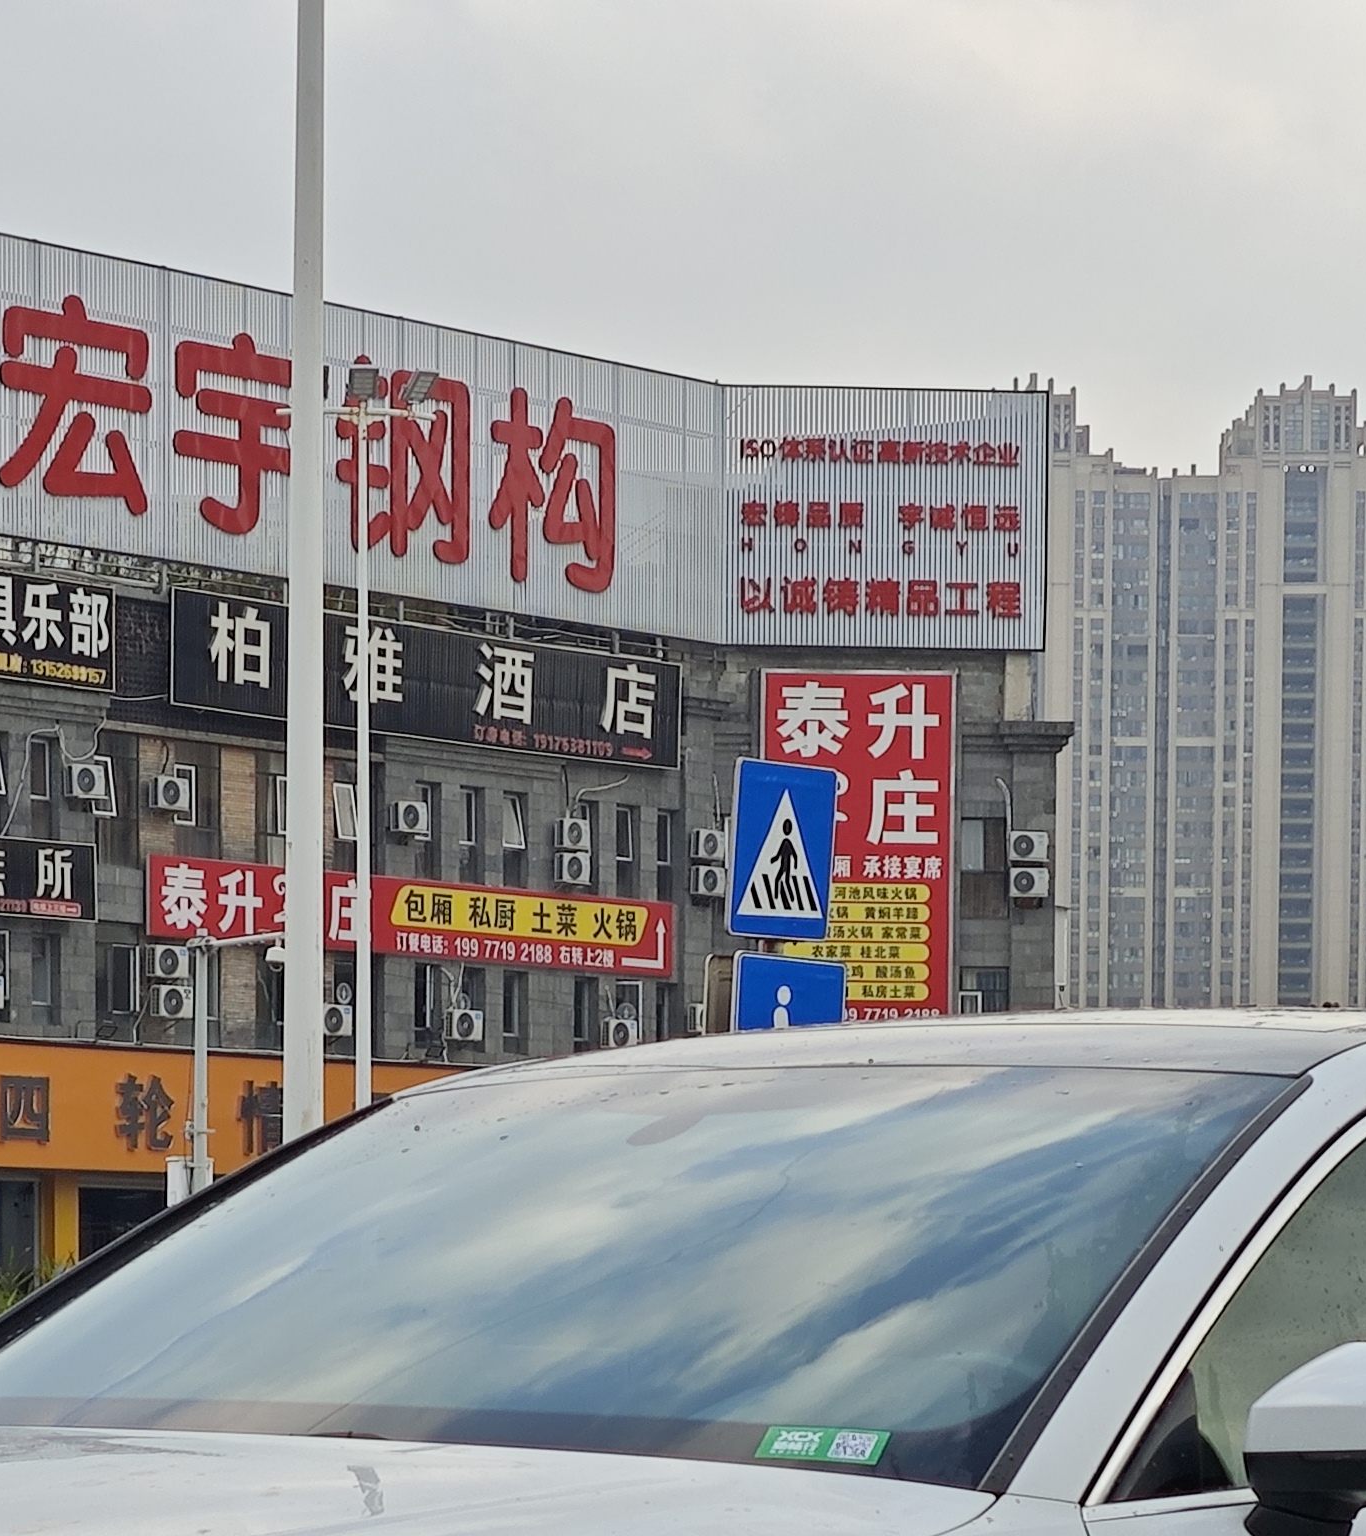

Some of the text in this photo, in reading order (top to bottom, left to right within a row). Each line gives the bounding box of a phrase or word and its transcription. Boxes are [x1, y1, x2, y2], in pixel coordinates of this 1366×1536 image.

[209, 600, 658, 740] 柏雅酒店
[776, 680, 941, 761] 泰升
[863, 855, 943, 880] 承接宴席
[834, 885, 918, 901] 河池风味火锅
[404, 889, 453, 926] 包厢
[468, 895, 516, 932] 私厨
[531, 902, 577, 938] 土菜
[593, 907, 638, 943] 火锅
[864, 906, 919, 921] 黄焖羊蹄
[881, 926, 922, 940] 家常菜
[454, 936, 479, 958] 199
[484, 938, 516, 962] 7719
[520, 941, 553, 965] 2188
[811, 944, 901, 960] 农家菜 桂北菜
[875, 965, 917, 979] 酸汤鱼
[861, 984, 917, 999] 私房土菜
